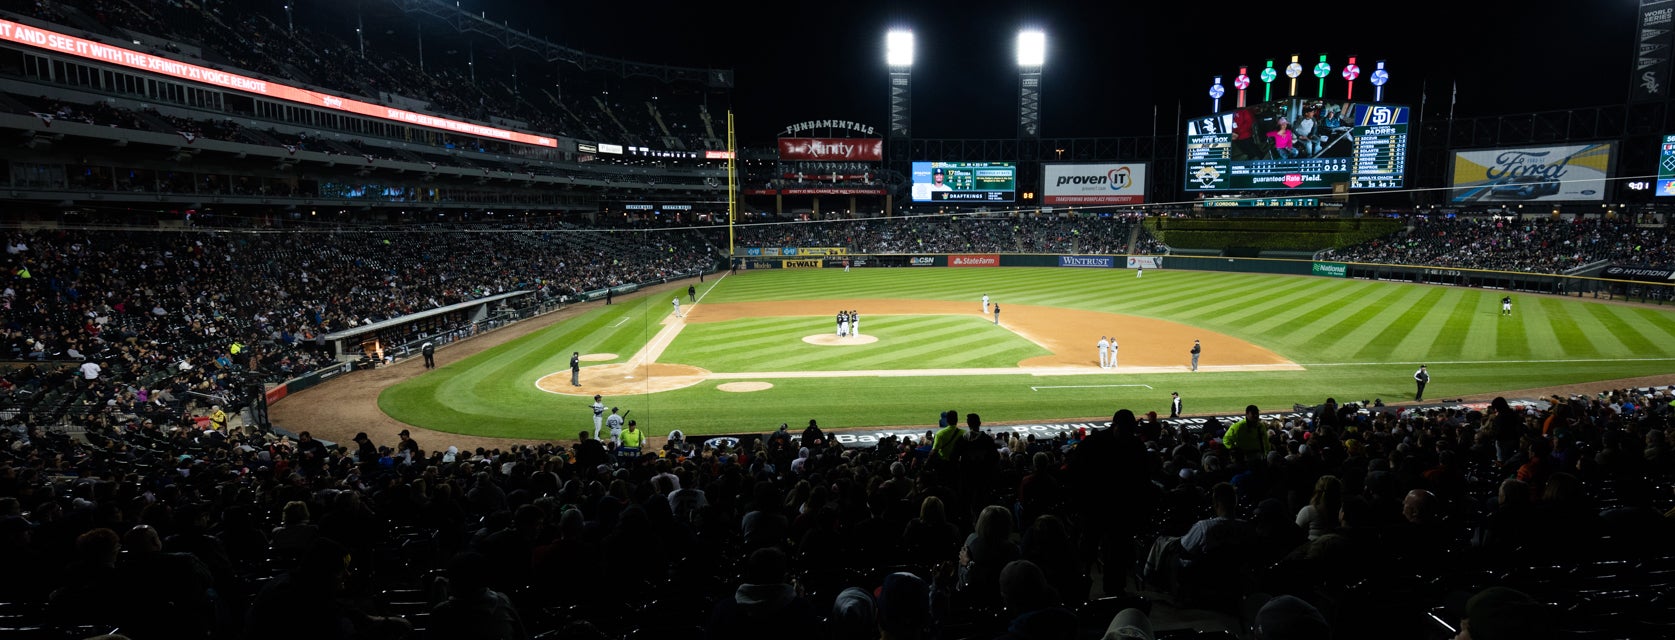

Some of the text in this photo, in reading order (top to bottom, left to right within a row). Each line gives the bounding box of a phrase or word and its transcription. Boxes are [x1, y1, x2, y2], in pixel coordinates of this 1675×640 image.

[1644, 8, 1672, 17] WORLD
[1644, 14, 1672, 22] SERIES
[15, 27, 46, 45] AND
[48, 34, 75, 52] SEE
[76, 42, 88, 54] IT
[90, 45, 122, 62] WITH
[124, 52, 148, 67] THE
[148, 58, 188, 76] XFINITY
[188, 68, 200, 78] X1
[201, 70, 230, 85] VOICE
[231, 77, 267, 92] REMOTE
[1372, 106, 1391, 126] SD
[786, 120, 874, 134] FUNDAMENTALS
[807, 140, 854, 158] xfinity
[1486, 151, 1568, 178] Ford
[1056, 174, 1126, 186] proven IT
[1628, 182, 1650, 190] 9:01
